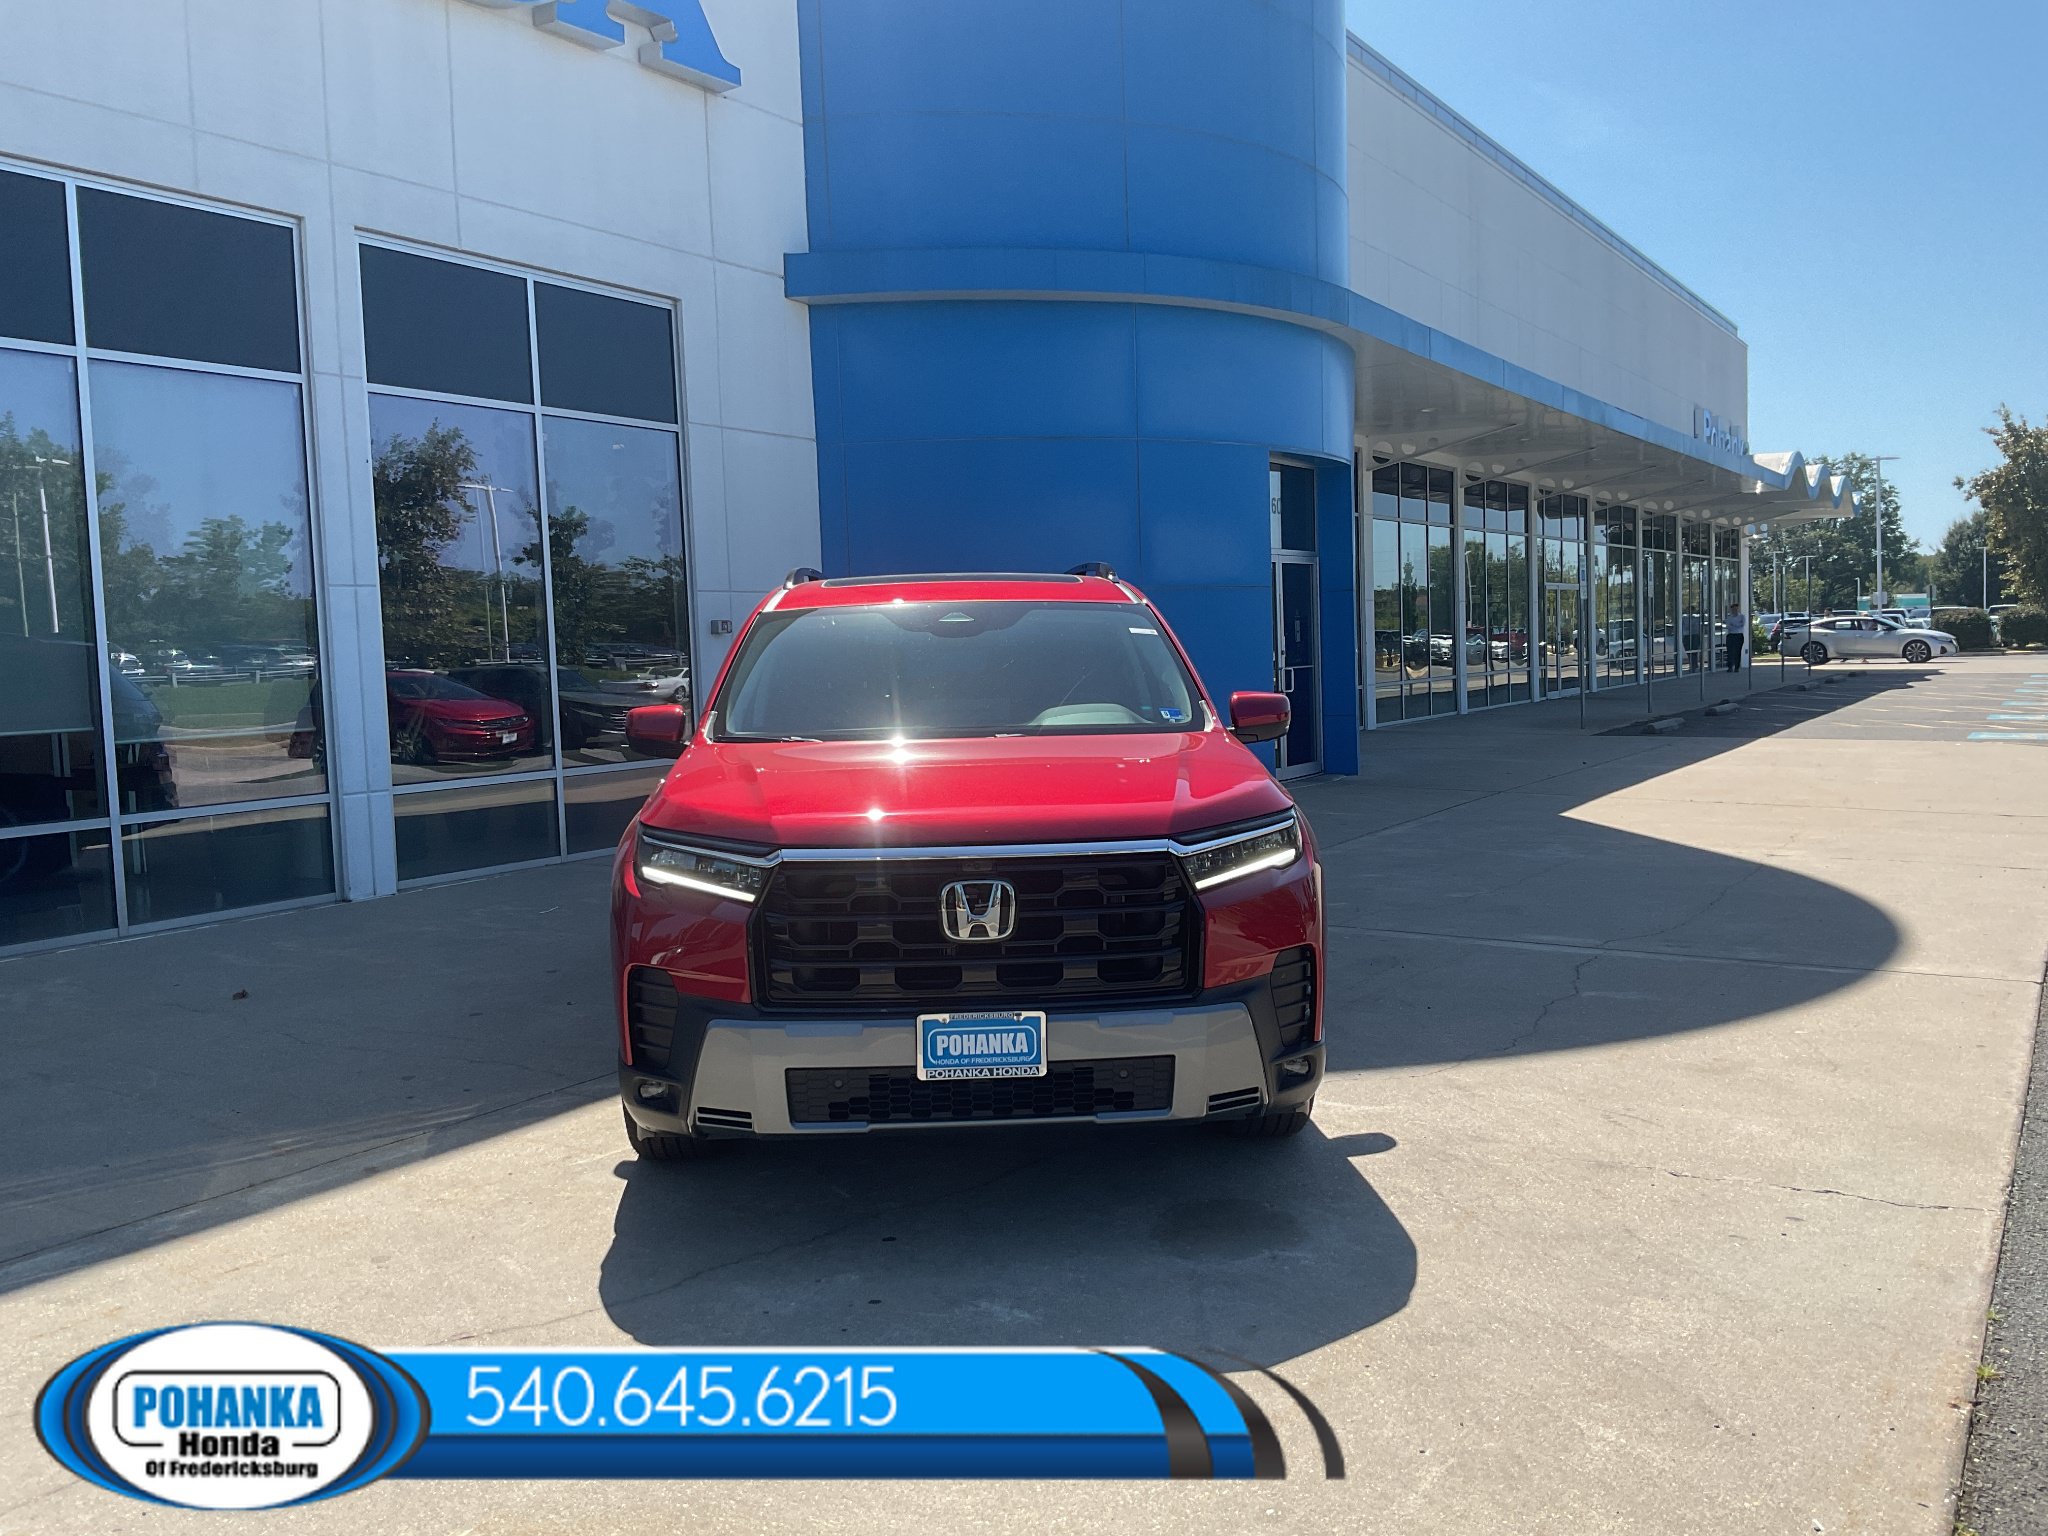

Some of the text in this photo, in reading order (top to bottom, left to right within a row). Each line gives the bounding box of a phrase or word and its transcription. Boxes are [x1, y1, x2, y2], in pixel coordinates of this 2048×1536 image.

[936, 1032, 1029, 1056] POHANKA
[971, 1056, 1031, 1064] FREDERICKSBURG
[927, 1066, 1039, 1079] POHANKA HONDA
